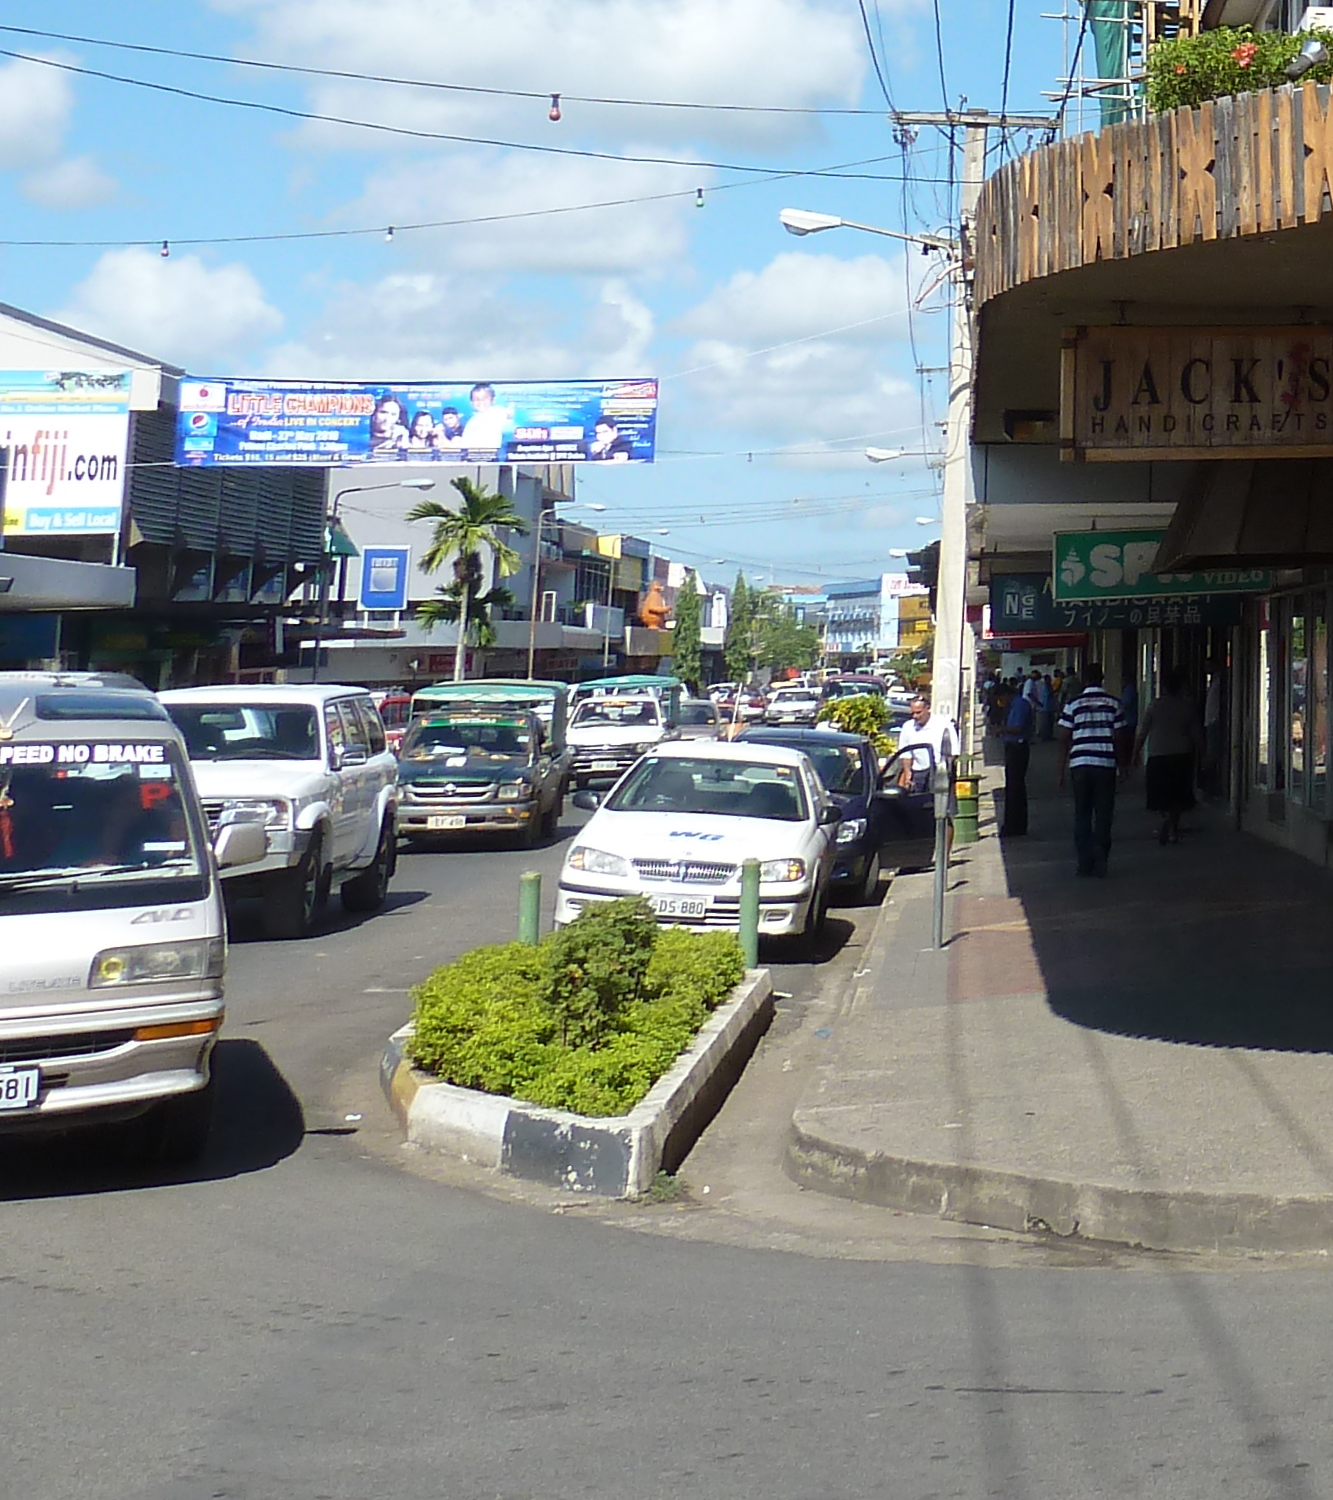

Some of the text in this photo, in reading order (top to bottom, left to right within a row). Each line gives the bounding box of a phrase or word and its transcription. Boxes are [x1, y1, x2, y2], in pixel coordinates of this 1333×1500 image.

[1091, 357, 1332, 413] JACK'S
[227, 393, 375, 415] LITTLE CHAMPIONS
[1090, 411, 1330, 435] HANDICRAFTS
[1202, 568, 1264, 585] VIDEO
[58, 744, 90, 763] NO
[94, 744, 164, 762] BRAKE
[0, 1076, 30, 1100] 81
